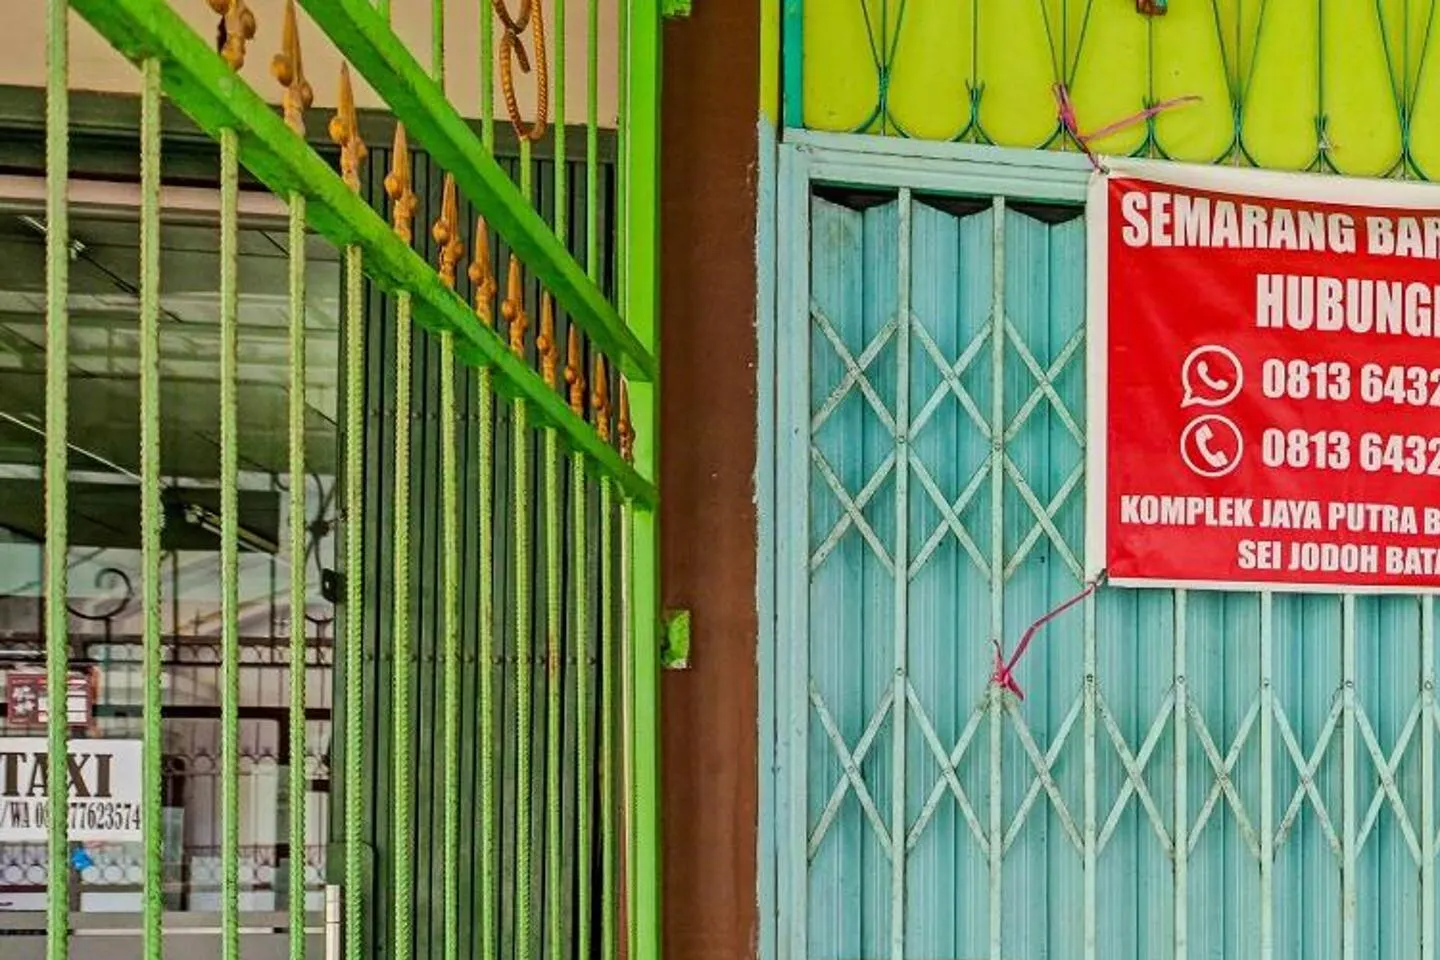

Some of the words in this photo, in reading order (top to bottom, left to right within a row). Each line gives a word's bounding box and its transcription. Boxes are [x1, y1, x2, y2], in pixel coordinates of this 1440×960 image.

[1121, 190, 1357, 254] SEMARANG
[1262, 358, 1351, 401] 0813
[1262, 428, 1351, 470] 0813
[1120, 495, 1255, 527] KOMPLEK
[1259, 499, 1322, 530] JAYA
[1328, 502, 1418, 535] PUTRA
[1238, 539, 1282, 570] SEI
[1287, 541, 1379, 573] JODOH
[0, 752, 114, 797] TAXI
